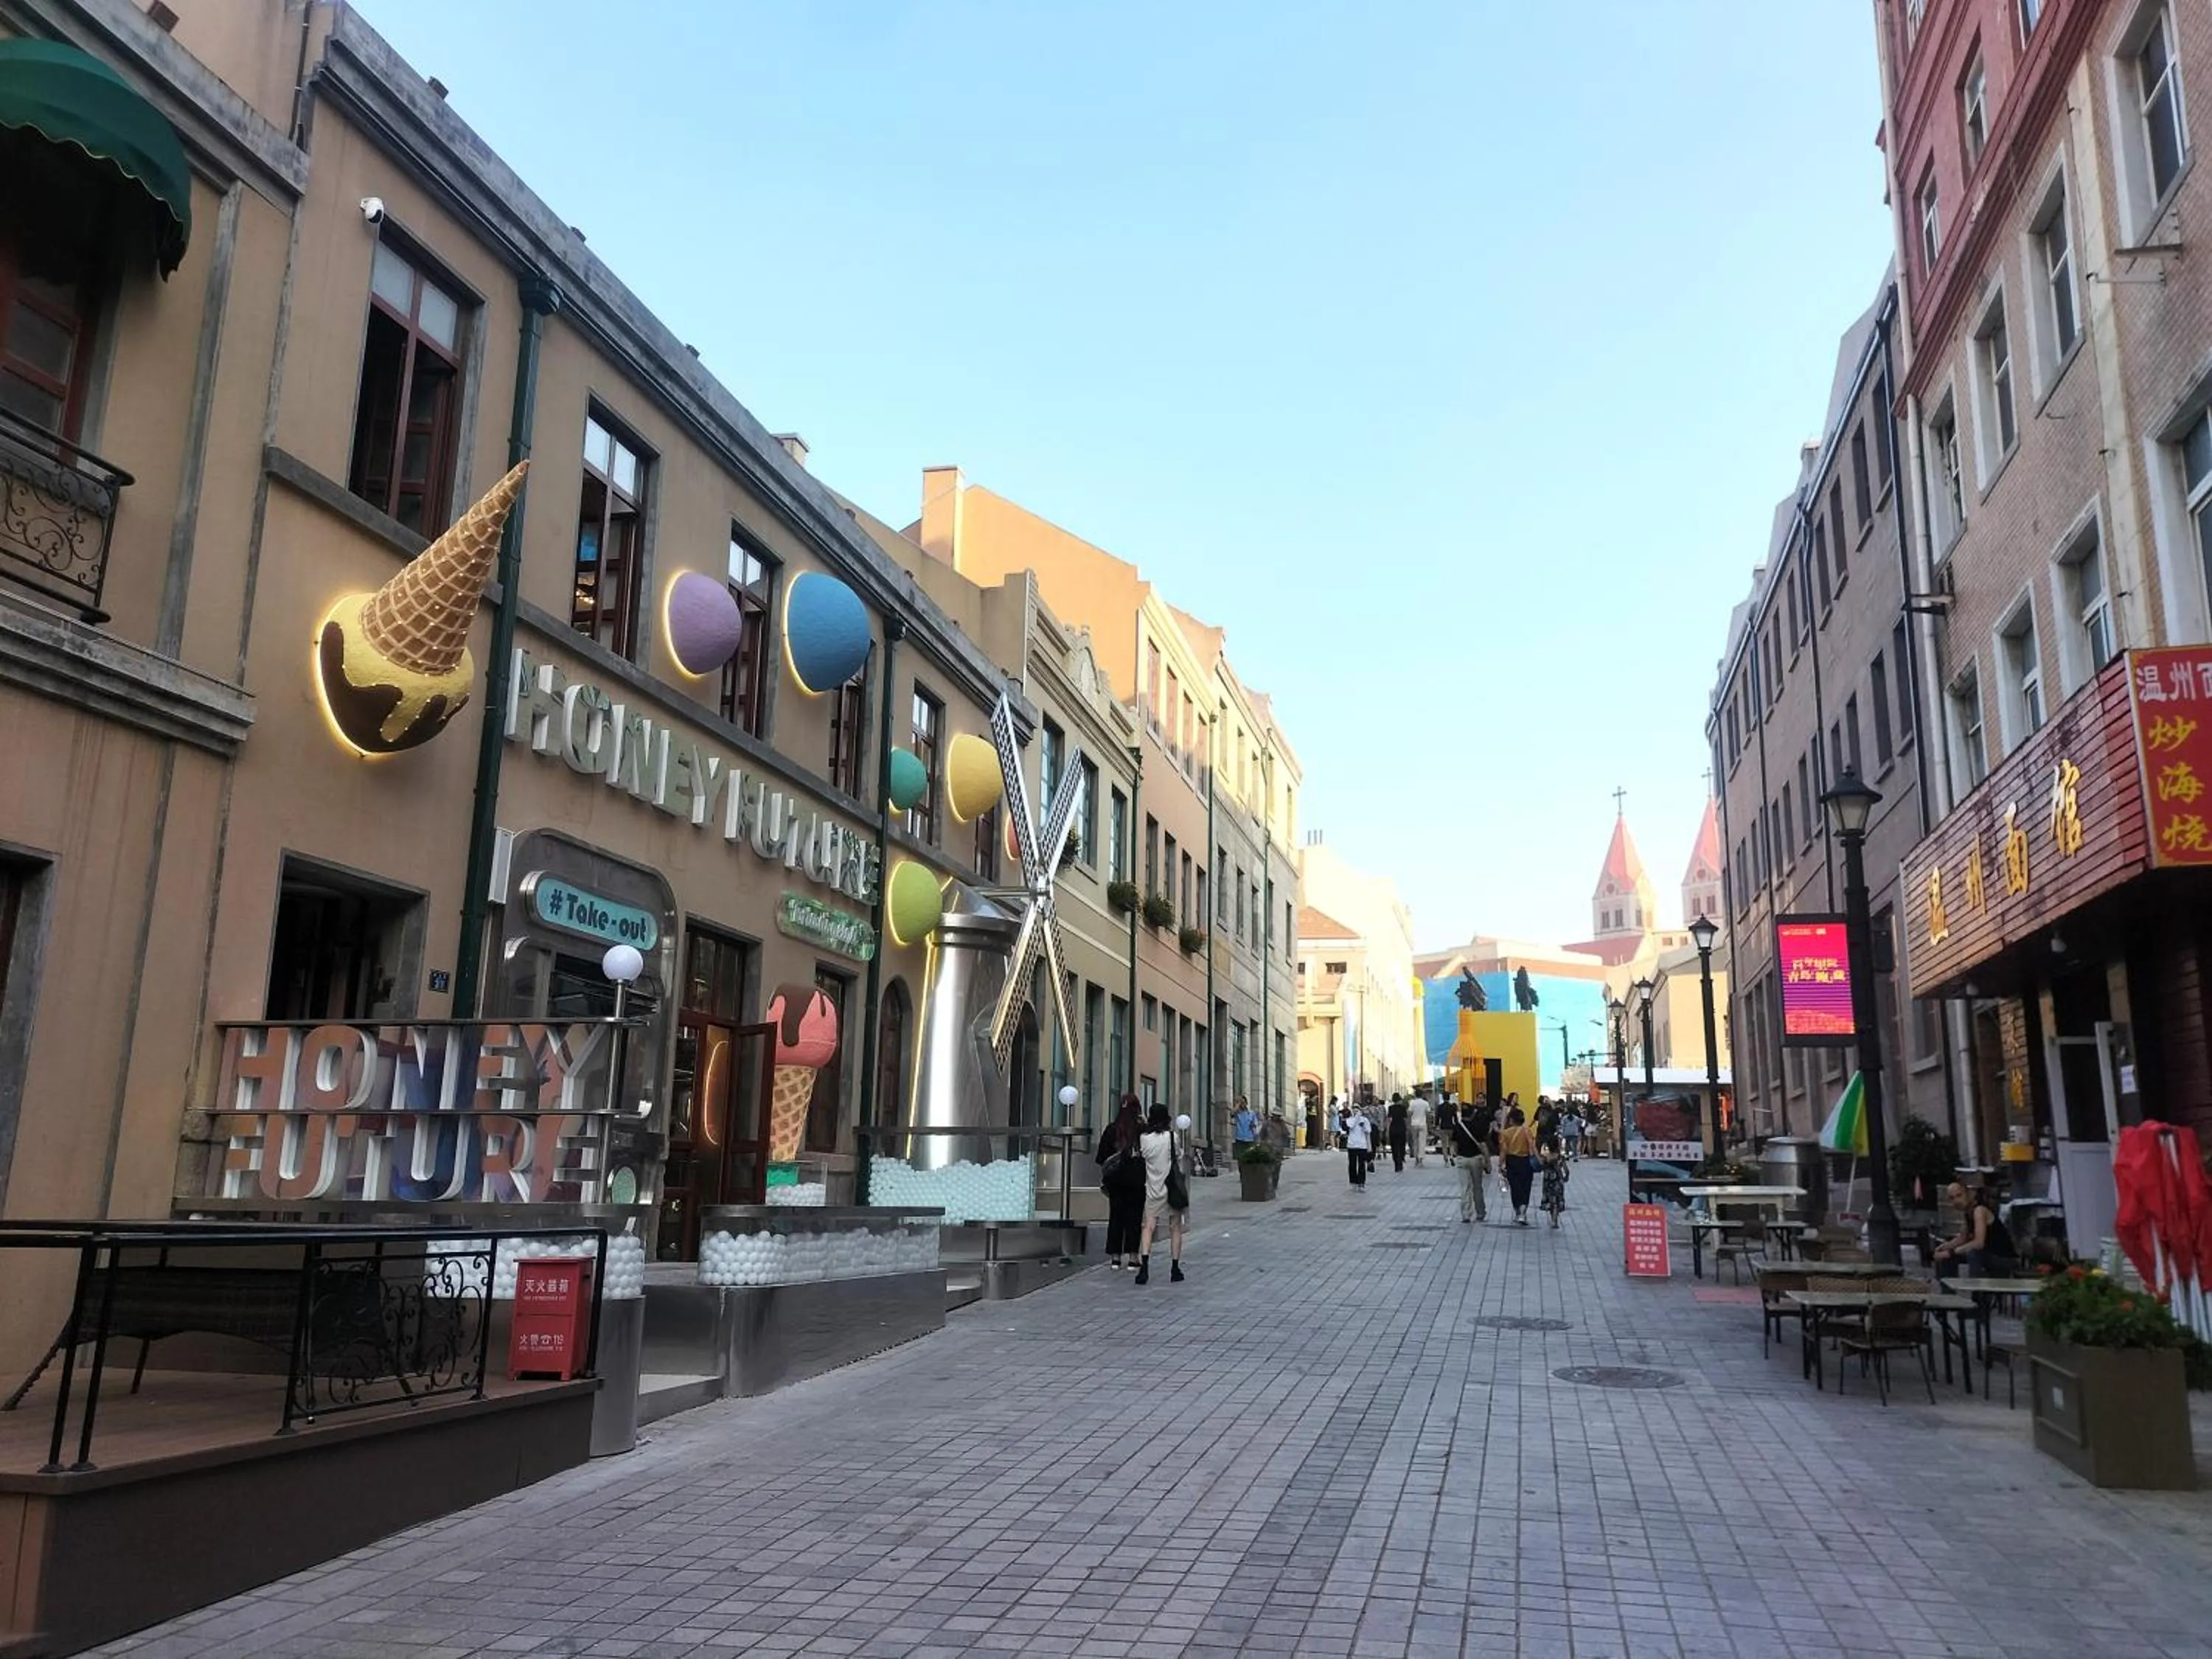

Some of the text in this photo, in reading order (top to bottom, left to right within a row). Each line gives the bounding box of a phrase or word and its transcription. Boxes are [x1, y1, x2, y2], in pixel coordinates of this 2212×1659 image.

[504, 647, 880, 906] HONEY FUTURE
[215, 1024, 605, 1109] HONEY
[206, 1113, 601, 1202] FUTURE
[524, 1279, 569, 1293] 灭火器箱
